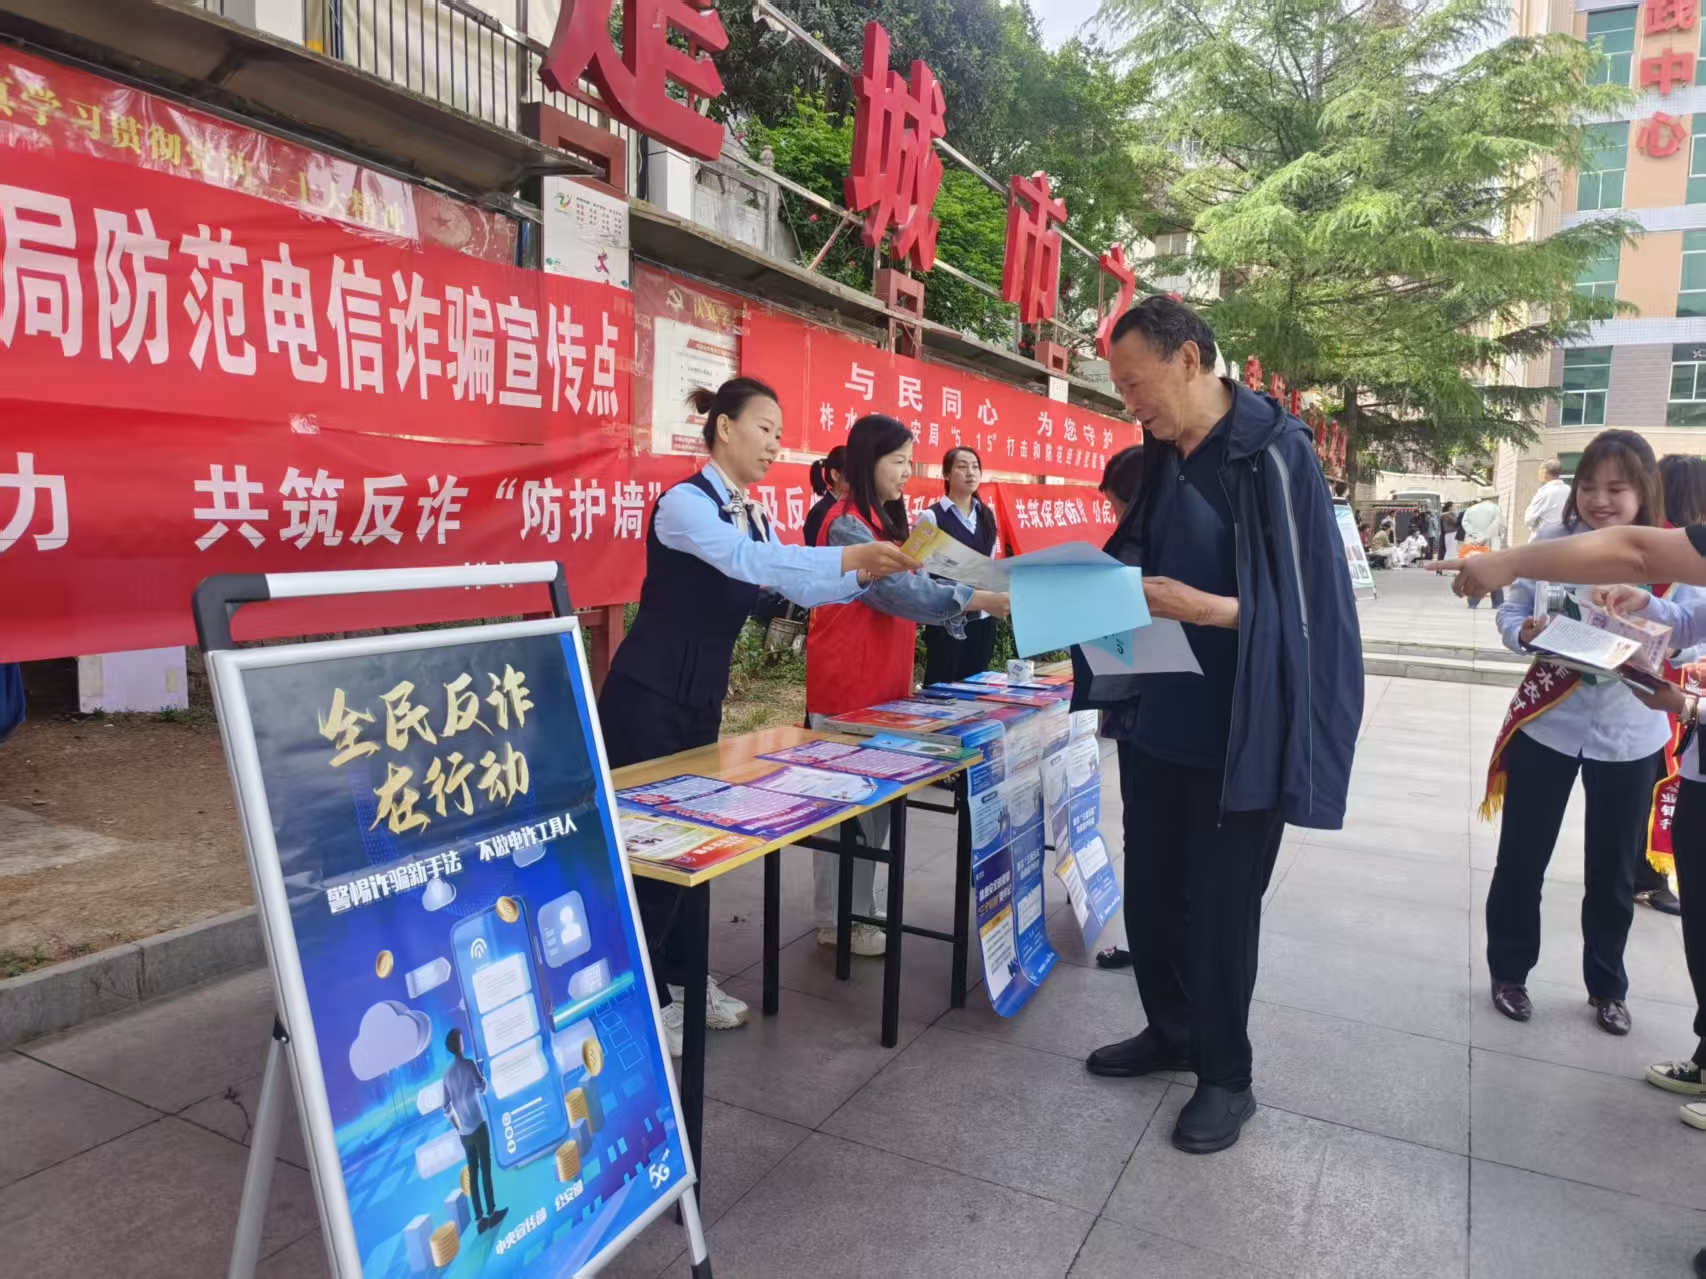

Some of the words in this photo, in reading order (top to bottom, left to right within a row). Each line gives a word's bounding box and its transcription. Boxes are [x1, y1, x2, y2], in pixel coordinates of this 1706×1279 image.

[0, 184, 620, 418] 局防范电信诈骗宣传点
[844, 361, 999, 426] 与民同心
[1036, 410, 1113, 449] 为您守护
[317, 662, 535, 767] 全民反诈
[369, 741, 531, 836] 在行动
[326, 850, 463, 915] 警惕诈骗新手法
[477, 811, 578, 862] 不做电诈工具人
